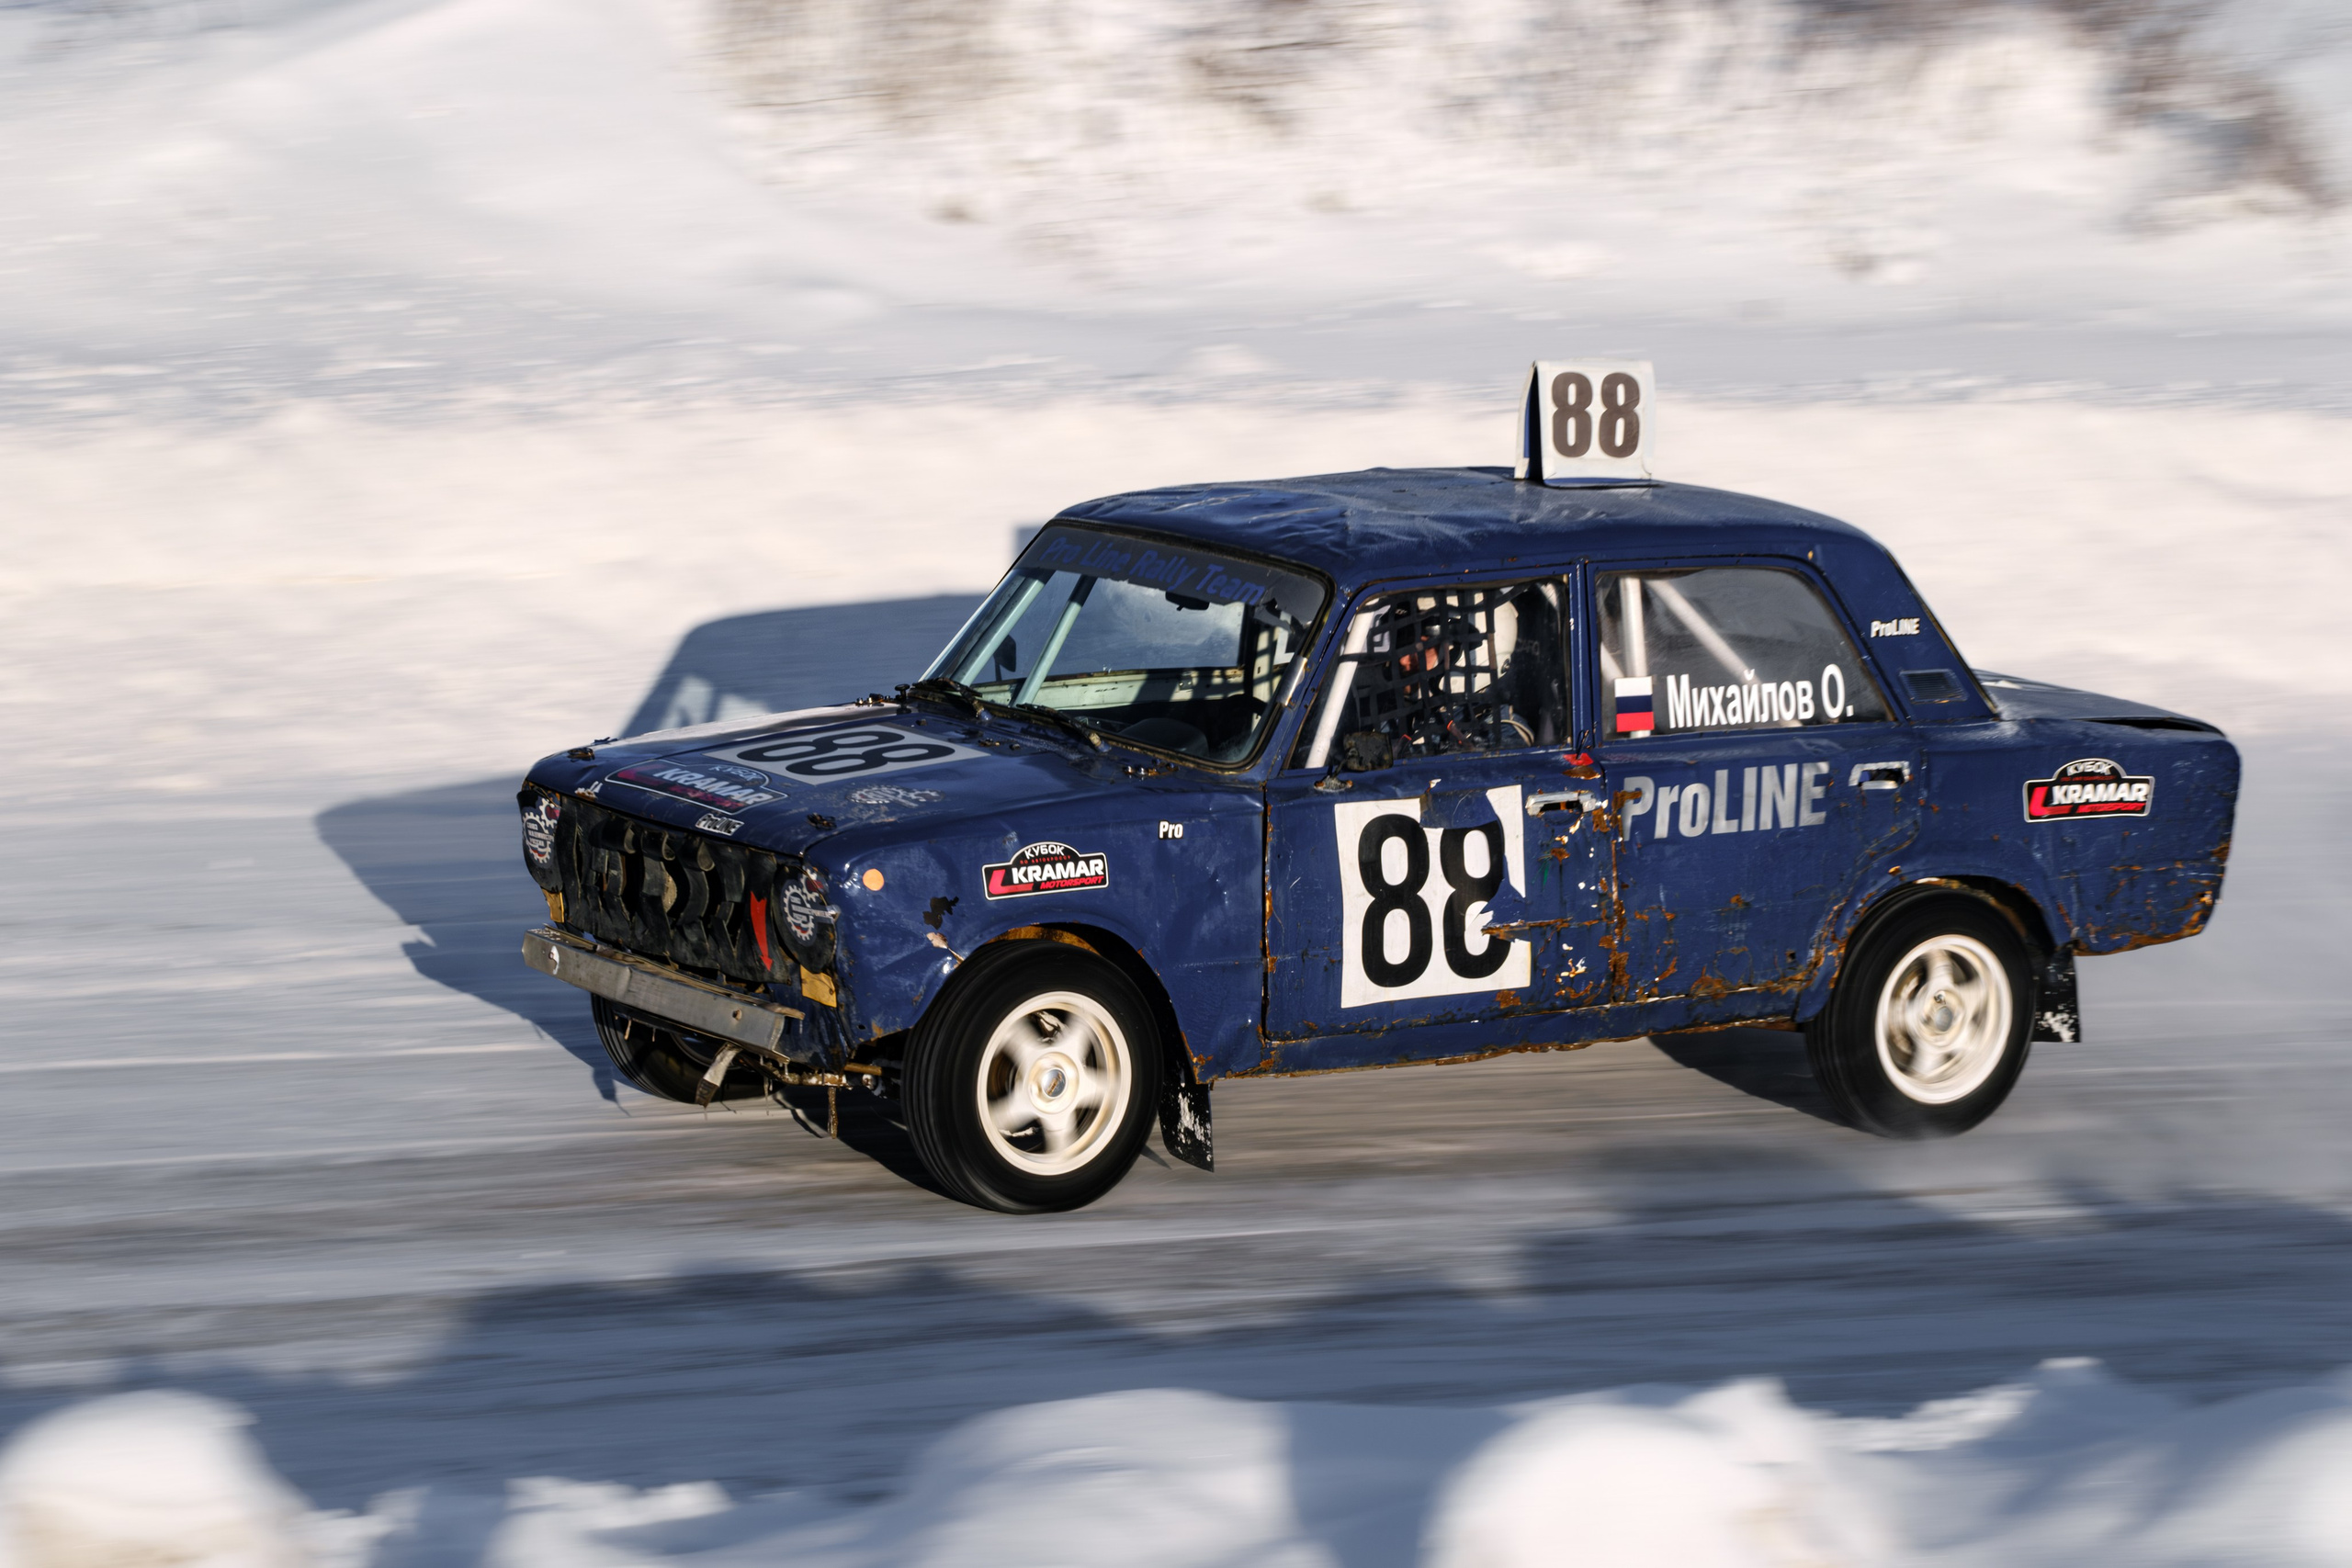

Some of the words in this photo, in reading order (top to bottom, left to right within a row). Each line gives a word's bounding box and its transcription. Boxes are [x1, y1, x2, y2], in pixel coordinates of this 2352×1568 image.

[1552, 372, 1640, 457] 88
[1039, 536, 1082, 564] Pro
[1080, 540, 1131, 573] Line
[1129, 550, 1197, 592] Rally
[1196, 563, 1266, 606] Team
[1871, 617, 1920, 637] ProLINE
[1667, 669, 1815, 728] Михайлов
[1821, 663, 1854, 718] О.
[737, 731, 956, 775] 88
[653, 768, 773, 806] KRAMAR
[1623, 761, 1830, 842] ProLINE
[2052, 783, 2150, 806] KRAMAR
[1159, 820, 1183, 839] Pro
[1024, 844, 1065, 860] КУБОК
[1012, 859, 1104, 885] KRAMAR
[1040, 875, 1104, 890] MOTORSPORT
[1358, 814, 1512, 988] 88
